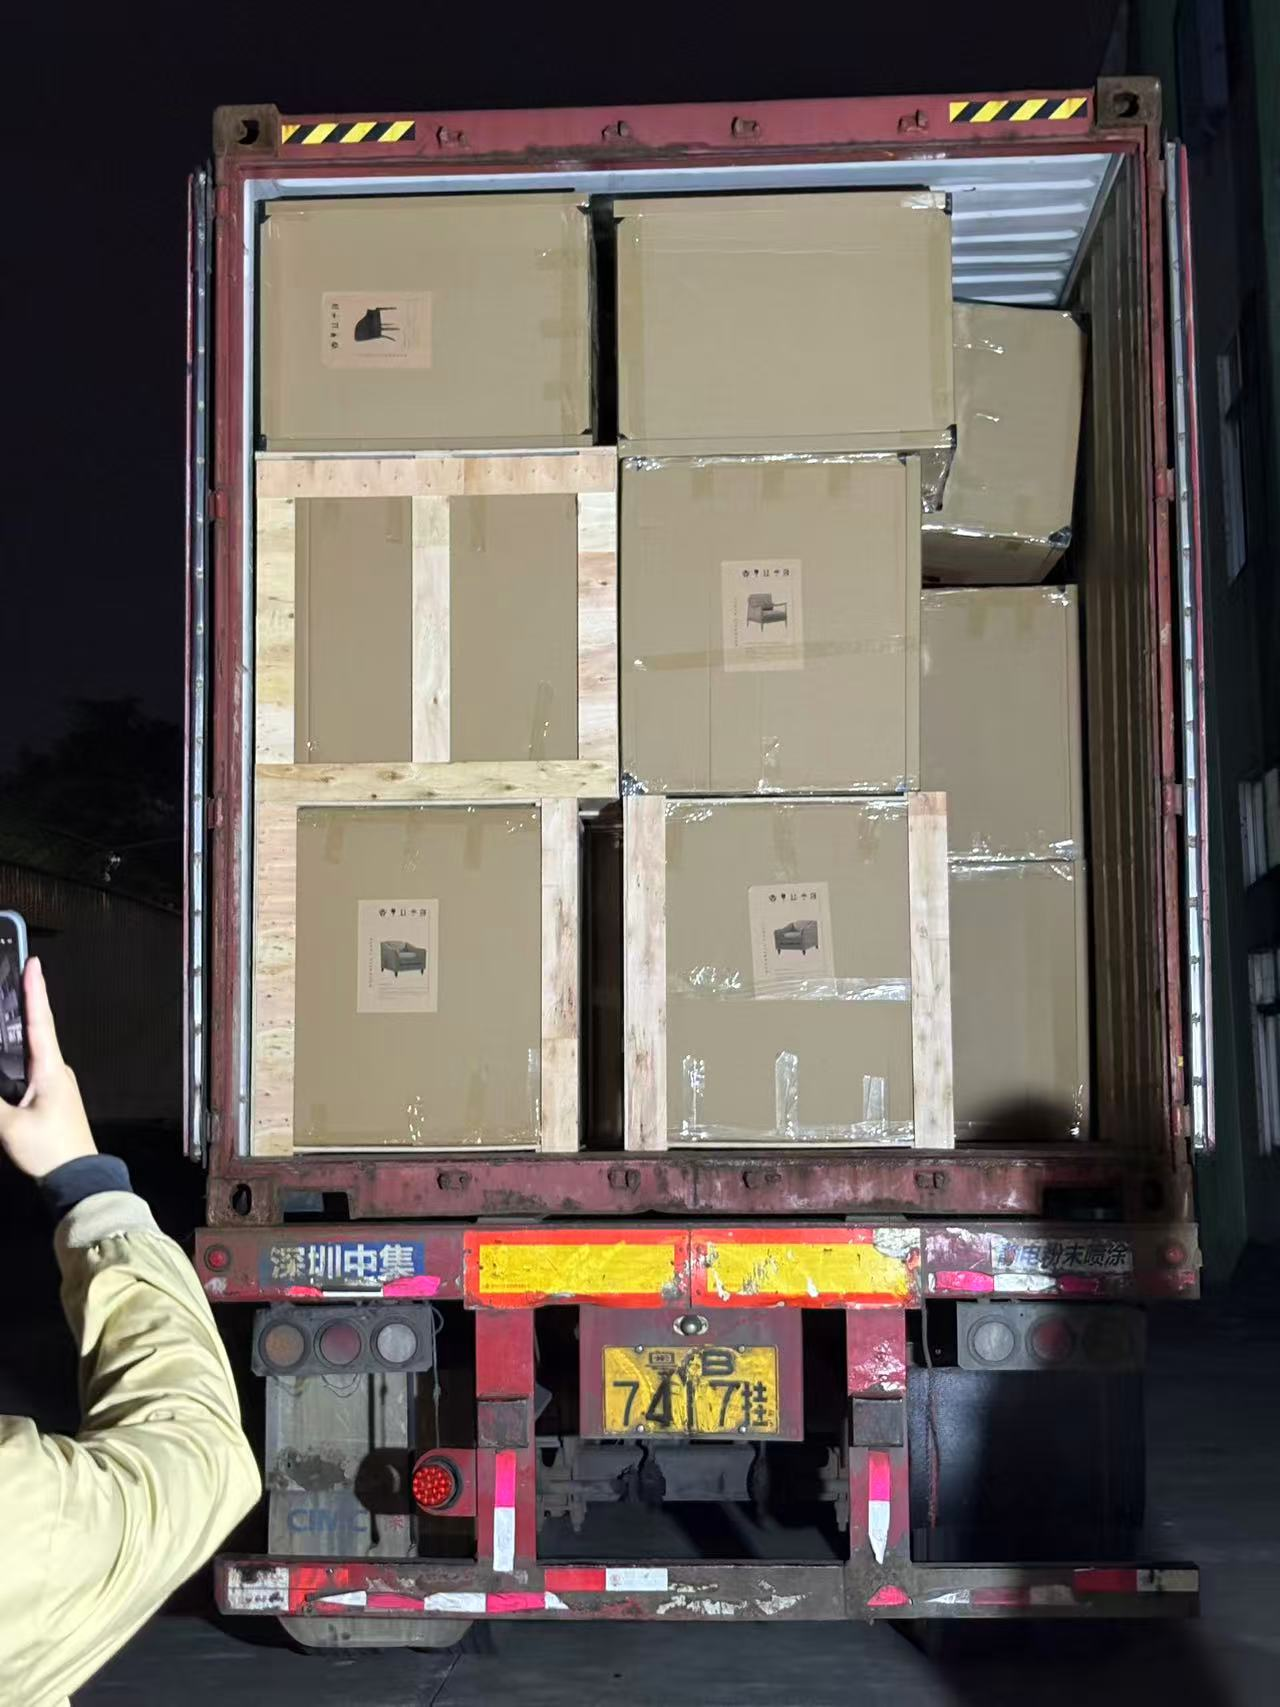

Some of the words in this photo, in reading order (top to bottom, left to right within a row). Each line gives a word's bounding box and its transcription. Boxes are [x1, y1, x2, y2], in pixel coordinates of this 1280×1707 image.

[270, 1243, 415, 1280] 深圳中集
[288, 1508, 369, 1532] CIMC
